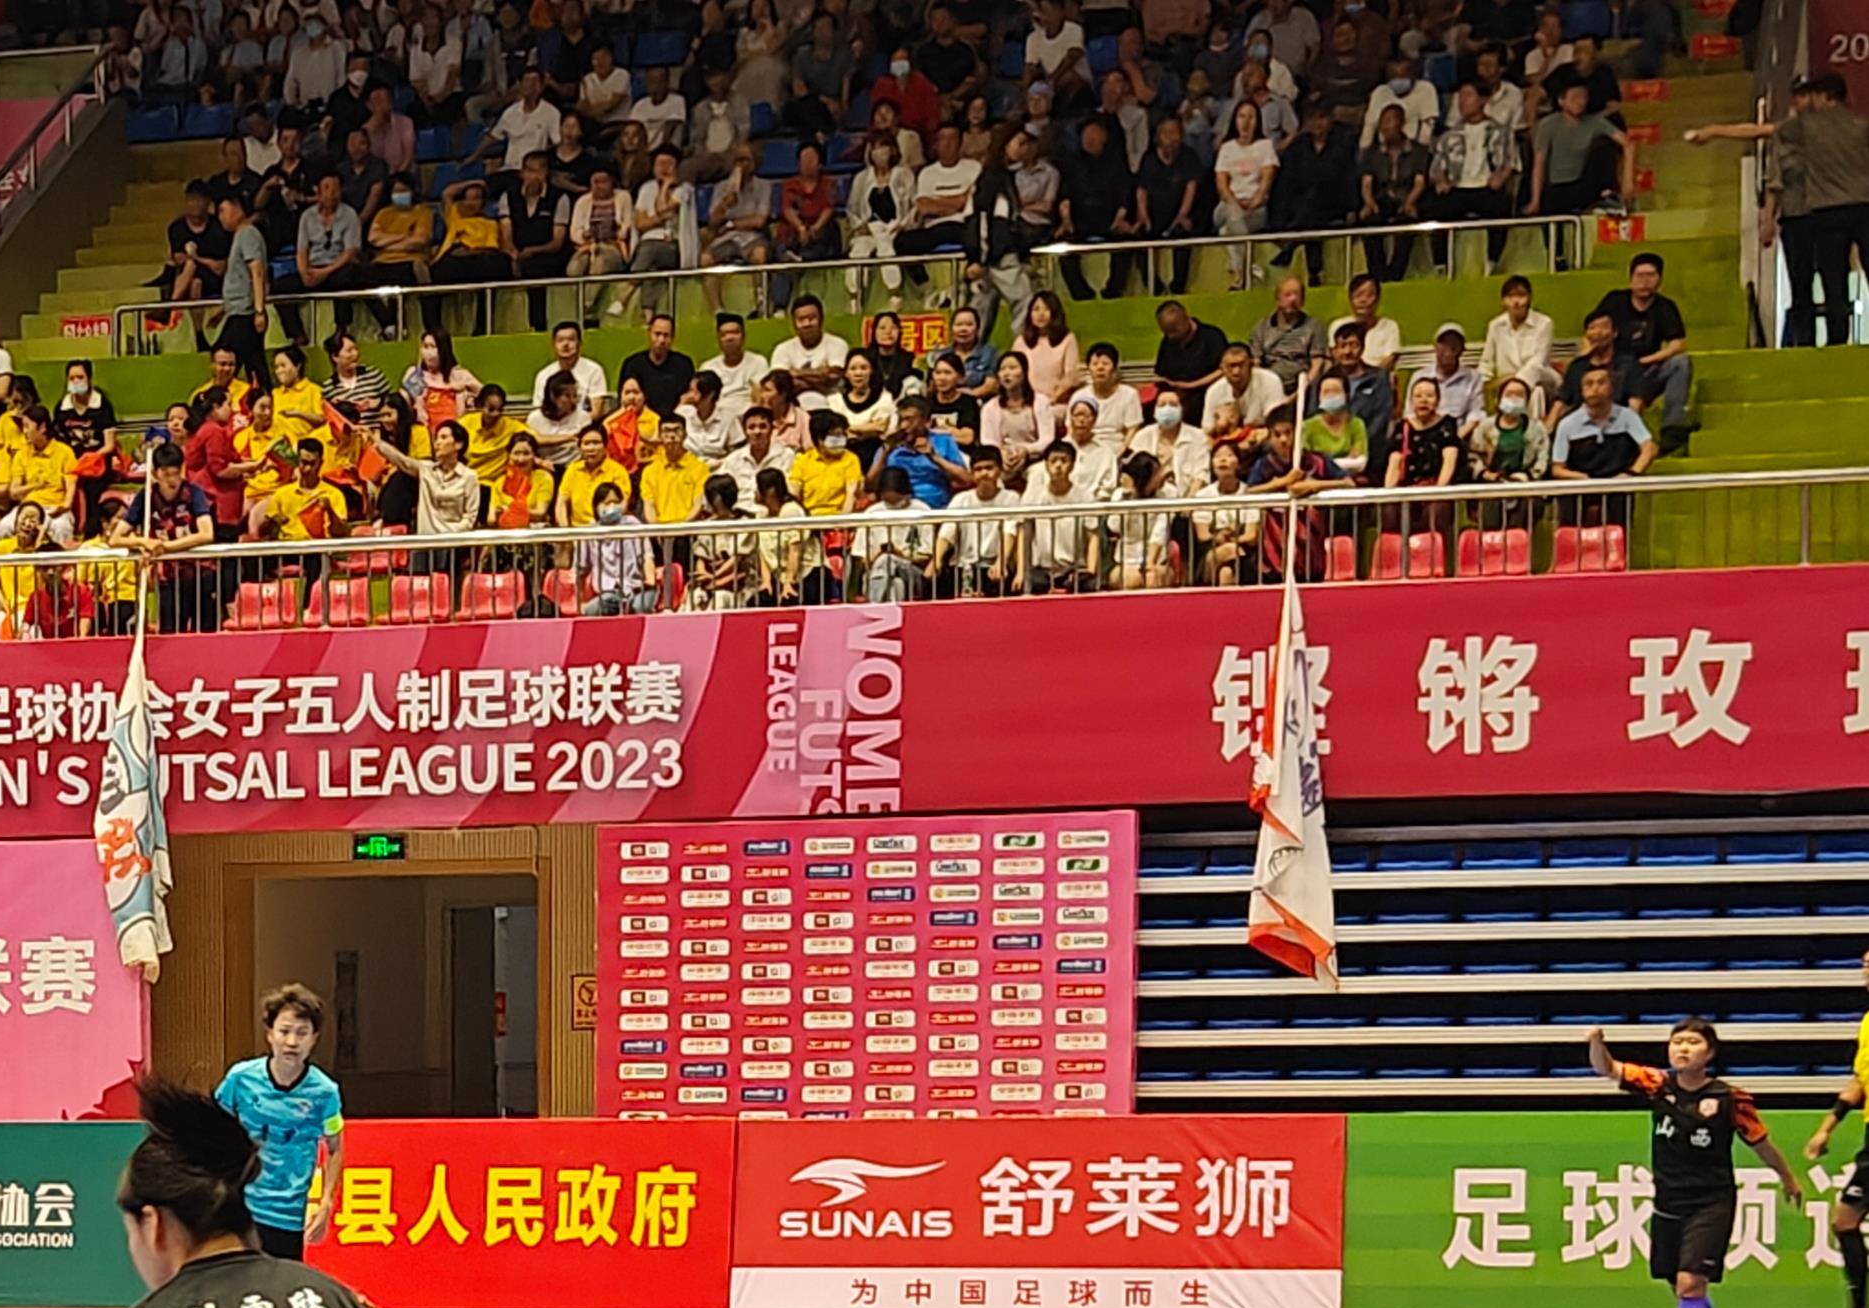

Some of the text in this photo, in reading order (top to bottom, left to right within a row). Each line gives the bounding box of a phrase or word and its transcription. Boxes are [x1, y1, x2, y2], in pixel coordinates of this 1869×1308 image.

[767, 623, 798, 772] LEAGUE
[318, 741, 536, 797] LEAGUE
[546, 738, 684, 793] 2023
[779, 1209, 953, 1239] SUNAIS
[979, 1156, 1295, 1239] 舒莱狮
[850, 1278, 1211, 1308] 为中国足球而生
